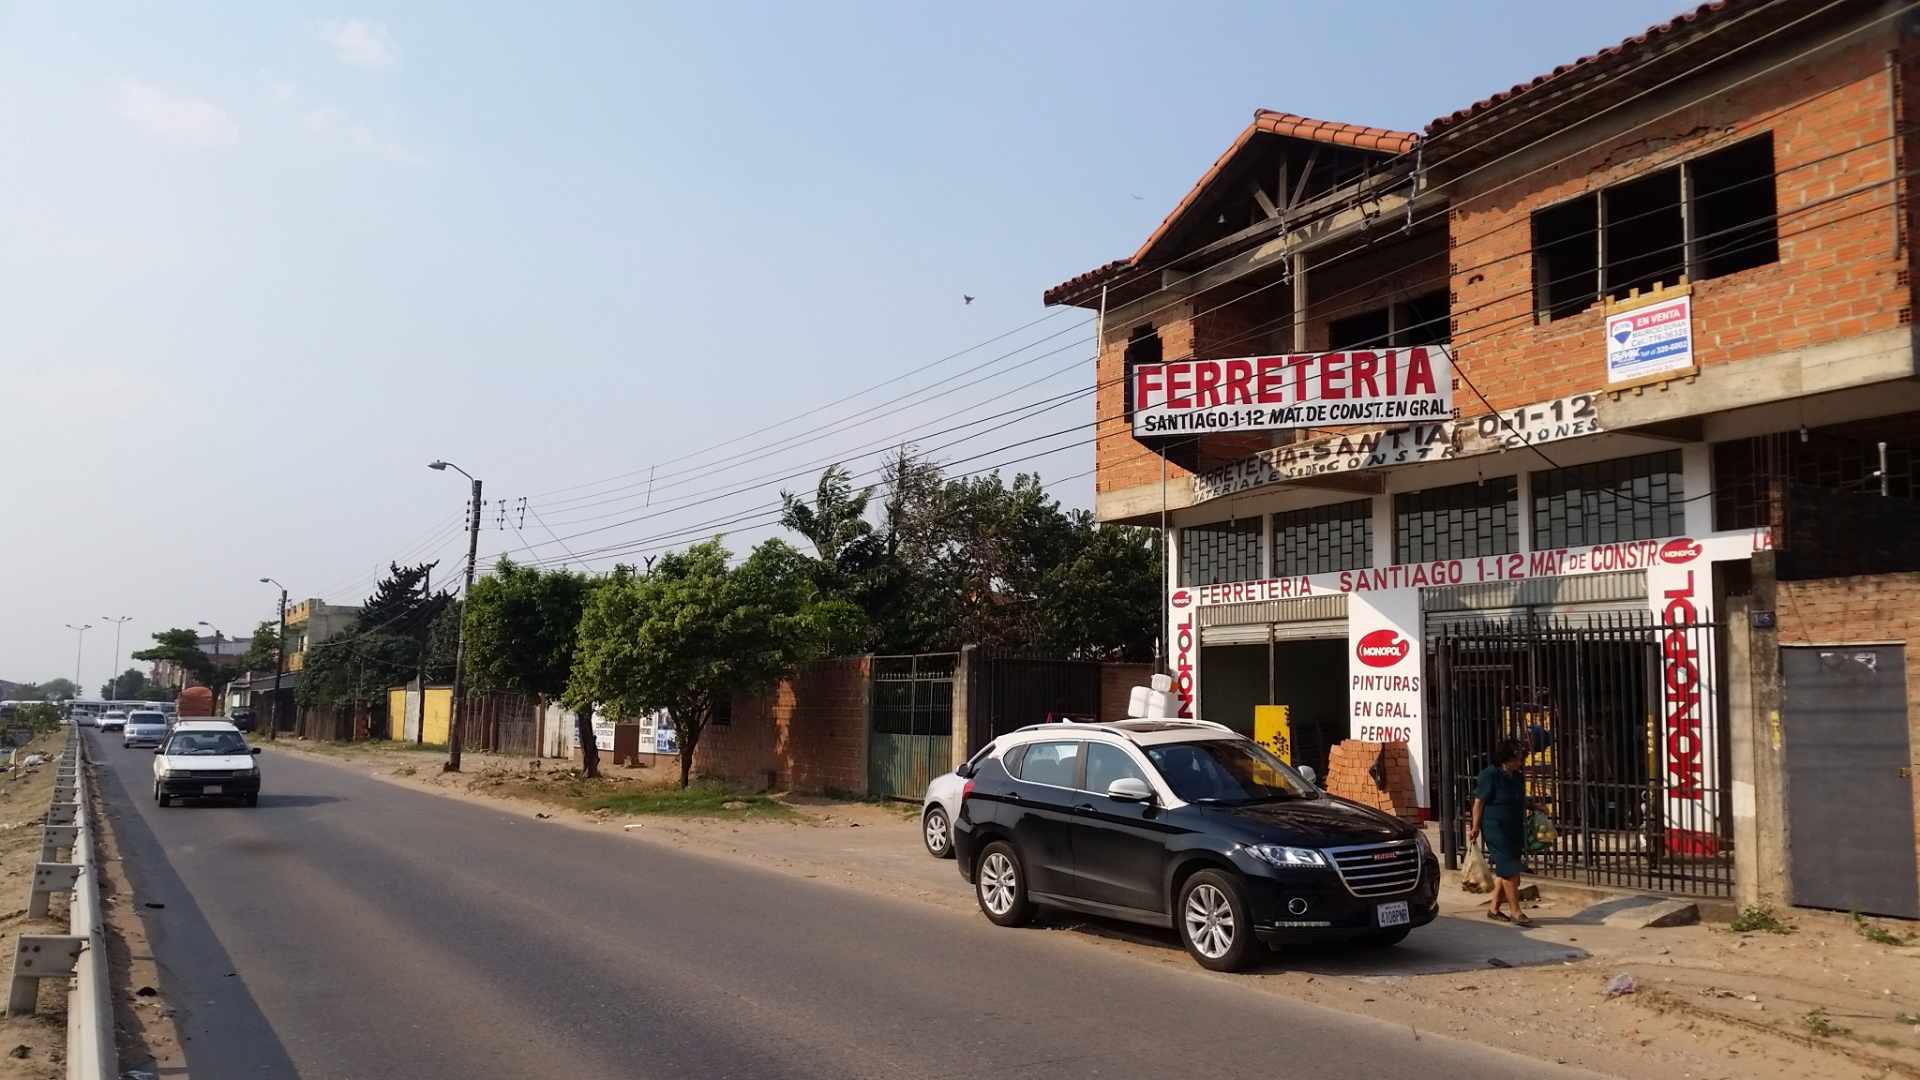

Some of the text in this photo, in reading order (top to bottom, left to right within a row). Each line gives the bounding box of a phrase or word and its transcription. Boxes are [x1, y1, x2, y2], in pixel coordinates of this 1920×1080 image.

[1637, 315, 1650, 327] EN
[1650, 308, 1680, 323] VENTA
[1137, 347, 1436, 410] FERRETERIA
[1144, 409, 1265, 432] SANTIAGO-1-12
[1409, 398, 1453, 416] GRAL.
[1200, 540, 1660, 605] FERRETERIA SANTIAGO 1-12 MAT. DE CONSTR.
[1363, 646, 1401, 657] MONOPOL
[1352, 675, 1420, 692] PINTURAS
[1664, 570, 1702, 800] MONOPOL
[1354, 701, 1417, 718] EN GRAL.
[1360, 726, 1411, 742] PERNOS
